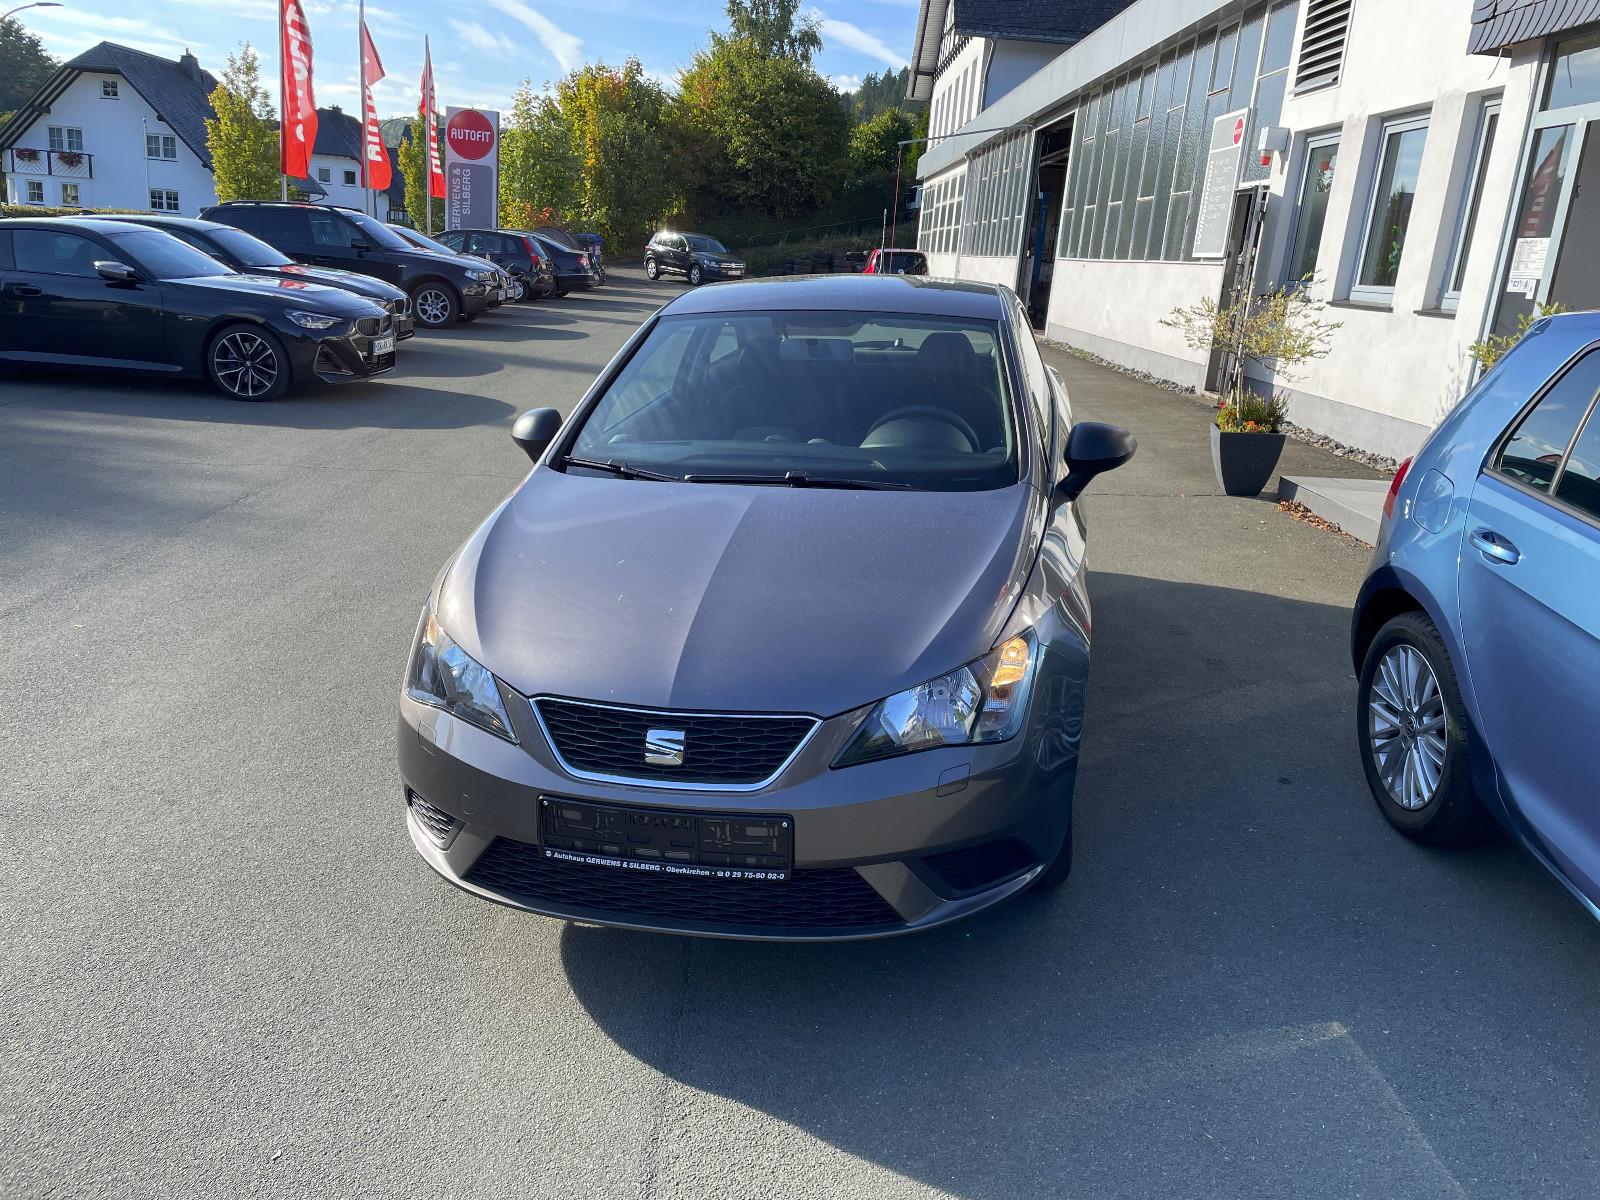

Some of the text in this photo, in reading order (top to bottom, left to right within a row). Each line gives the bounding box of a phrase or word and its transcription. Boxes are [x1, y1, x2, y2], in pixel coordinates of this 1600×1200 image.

[450, 127, 491, 143] AUTOFIT
[452, 177, 461, 230] GERWENS
[462, 168, 471, 215] SILBERG
[554, 851, 584, 862] Autohaus
[586, 857, 620, 867] GERWENS
[629, 862, 660, 871] SILBERG
[666, 865, 710, 876] Oberkirchen
